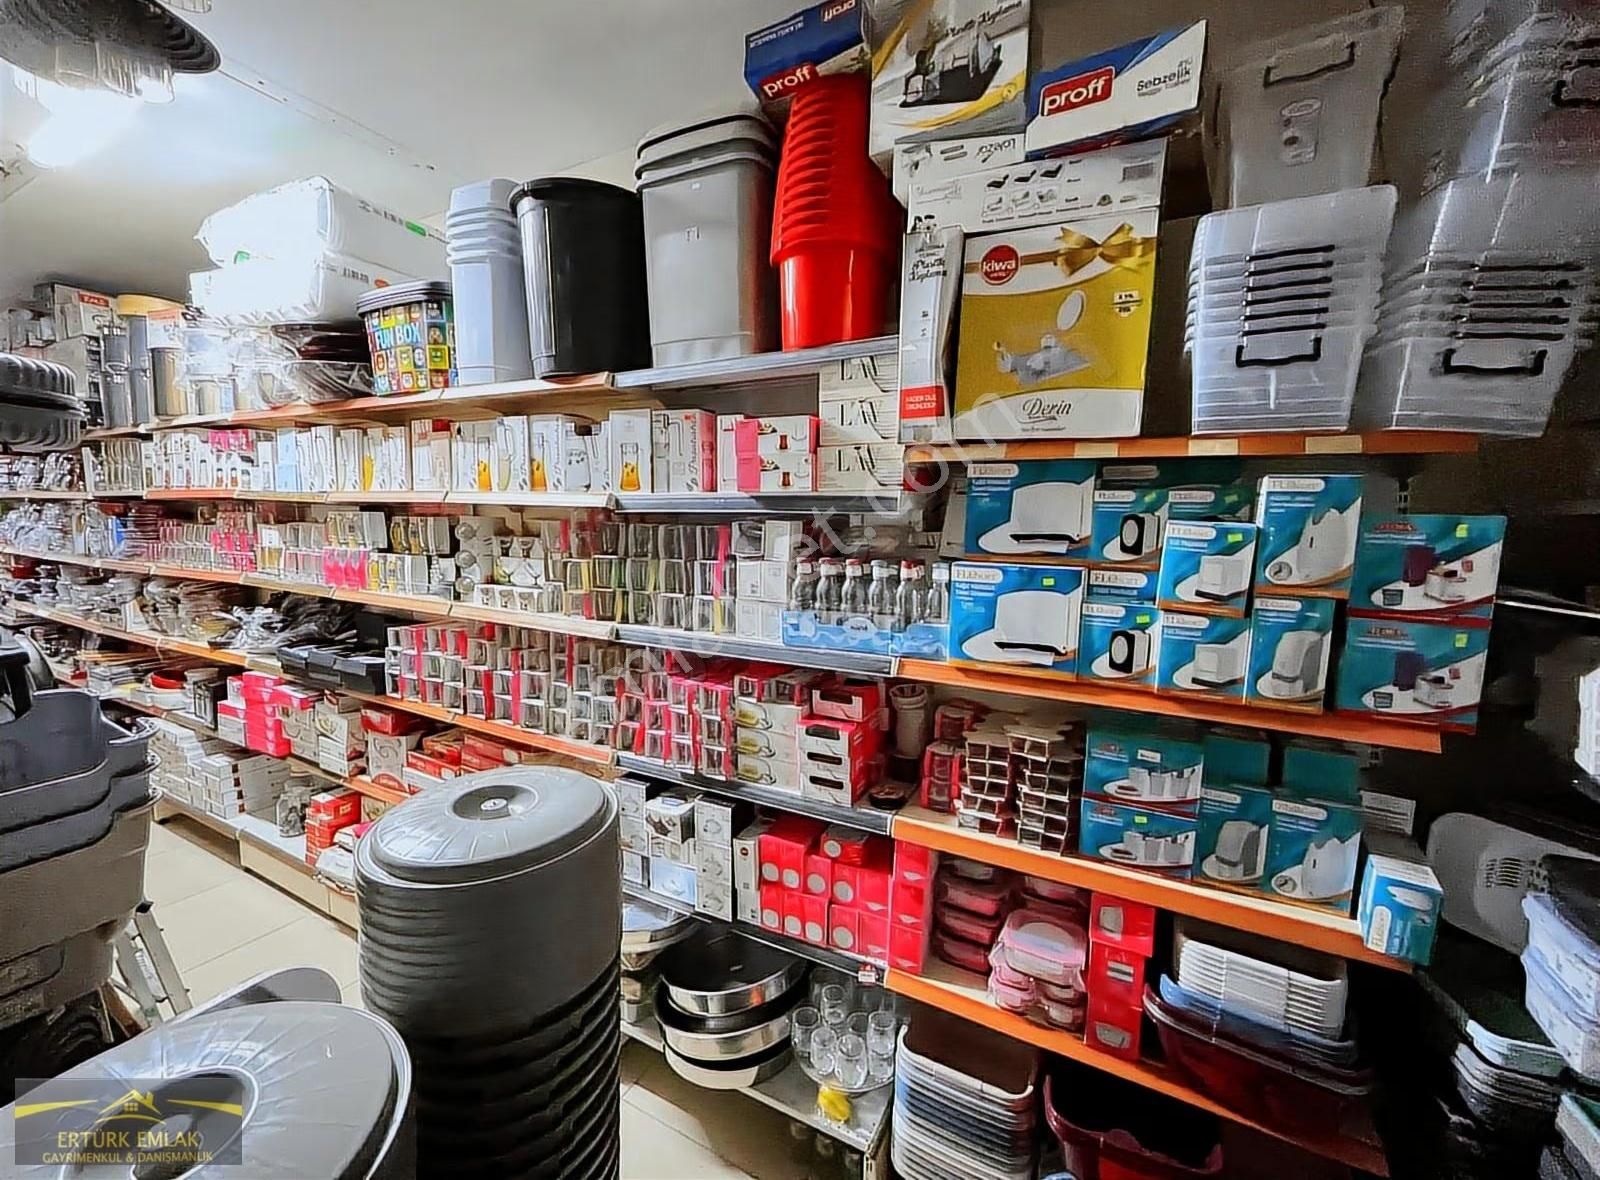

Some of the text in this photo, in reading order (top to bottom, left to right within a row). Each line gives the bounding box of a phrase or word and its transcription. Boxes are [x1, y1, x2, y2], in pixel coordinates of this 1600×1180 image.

[763, 65, 811, 98] proff
[1137, 67, 1191, 92] Sebzelik
[1044, 75, 1110, 117] proff
[983, 260, 1016, 272] kiwa
[395, 321, 422, 346] BOX
[1022, 397, 1072, 417] Derin
